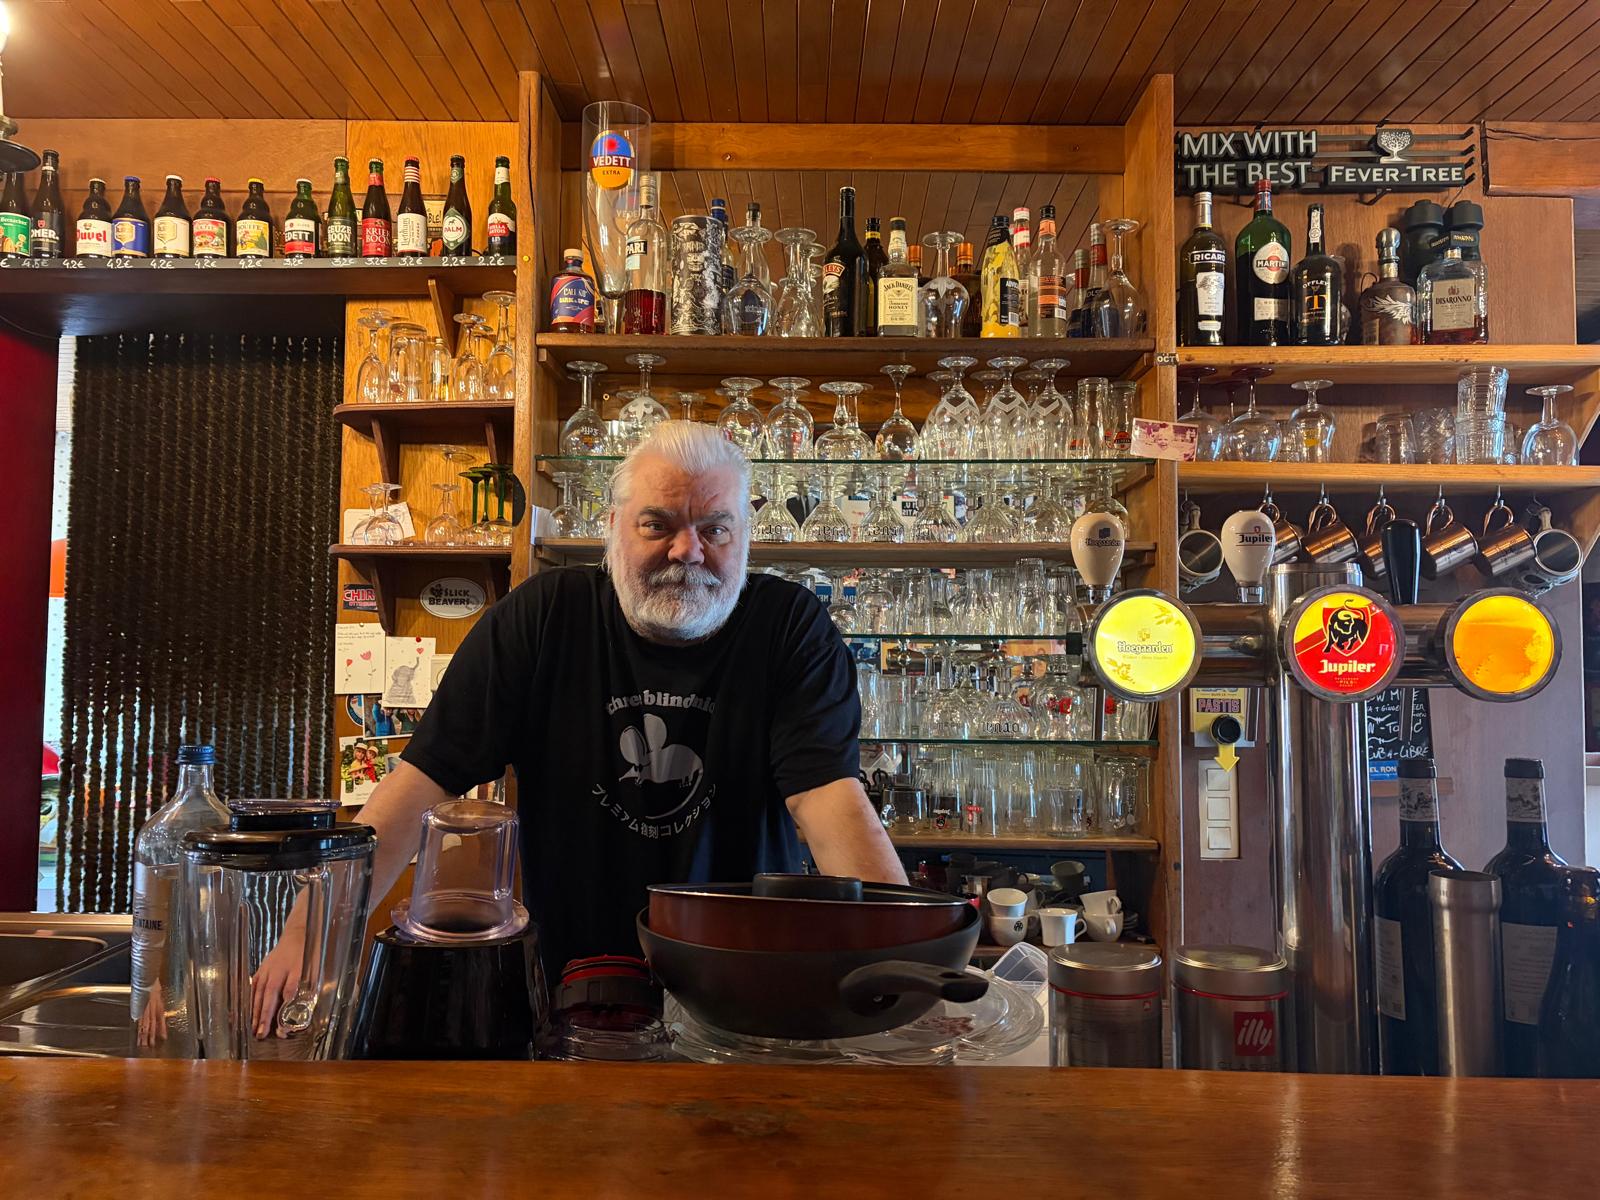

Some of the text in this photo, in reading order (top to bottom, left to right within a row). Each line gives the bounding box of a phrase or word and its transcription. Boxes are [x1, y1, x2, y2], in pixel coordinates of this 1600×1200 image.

[1183, 131, 1317, 157] MIX WITH
[593, 156, 631, 167] VEDETT
[1184, 161, 1311, 186] THE BEST
[1331, 166, 1463, 182] FEVER-TREE
[285, 231, 310, 242] EDETT
[1193, 253, 1226, 261] RICARD
[1257, 260, 1286, 268] MARTIN
[884, 283, 896, 291] JACK
[1302, 280, 1329, 288] OFFLEY
[1087, 290, 1101, 298] OLS
[1436, 295, 1472, 305] DISARONNO
[1157, 355, 1174, 363] OCT
[1117, 640, 1172, 655] Hoegaarden
[1318, 659, 1376, 675] Jupiler
[643, 690, 695, 708] blind
[1197, 698, 1240, 713] PASTIS
[1237, 1018, 1273, 1052] illy
